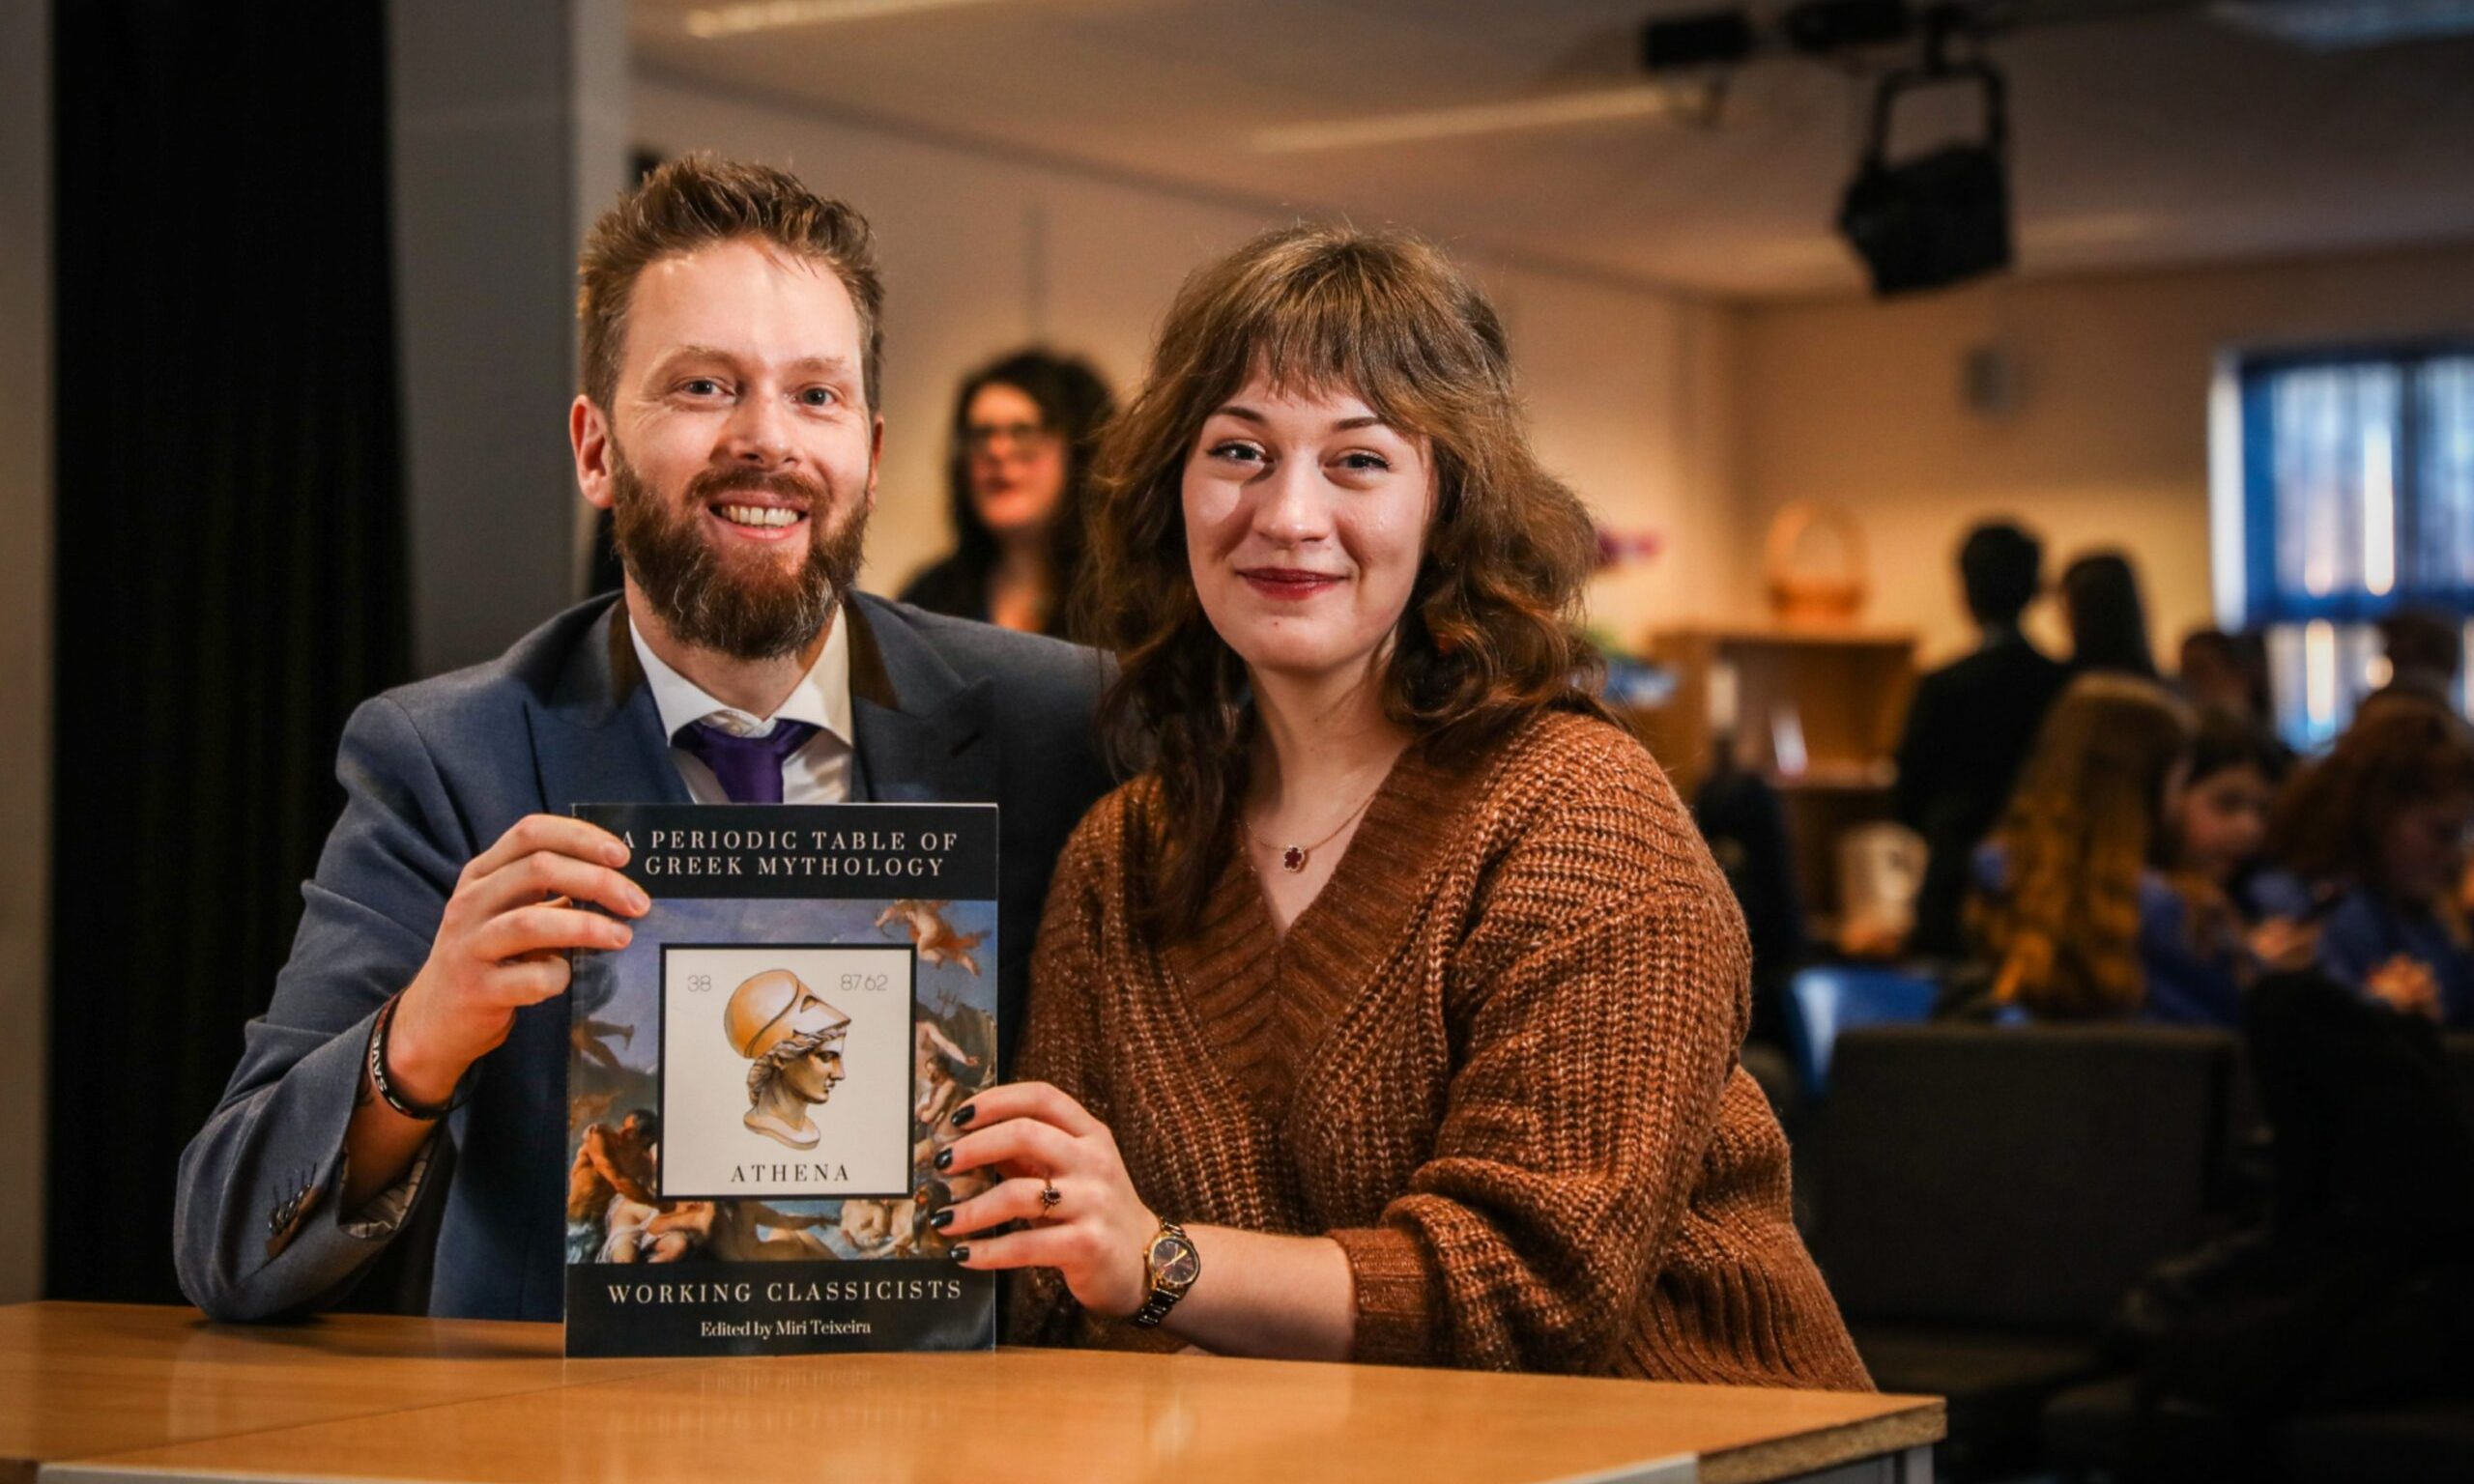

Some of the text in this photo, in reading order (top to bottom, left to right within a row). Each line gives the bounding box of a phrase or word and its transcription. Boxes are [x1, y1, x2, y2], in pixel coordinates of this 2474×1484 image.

[622, 830, 958, 851] A PERIODIC TABLE OF
[645, 856, 943, 876] GREEK MYTHOLOGY
[687, 974, 712, 993] 38
[372, 1034, 387, 1092] SAVE
[731, 1163, 849, 1183] ATHENA
[608, 1280, 961, 1303] WORKING CLASSICISTS
[701, 1319, 872, 1340] Edited by Miri Teixeira
